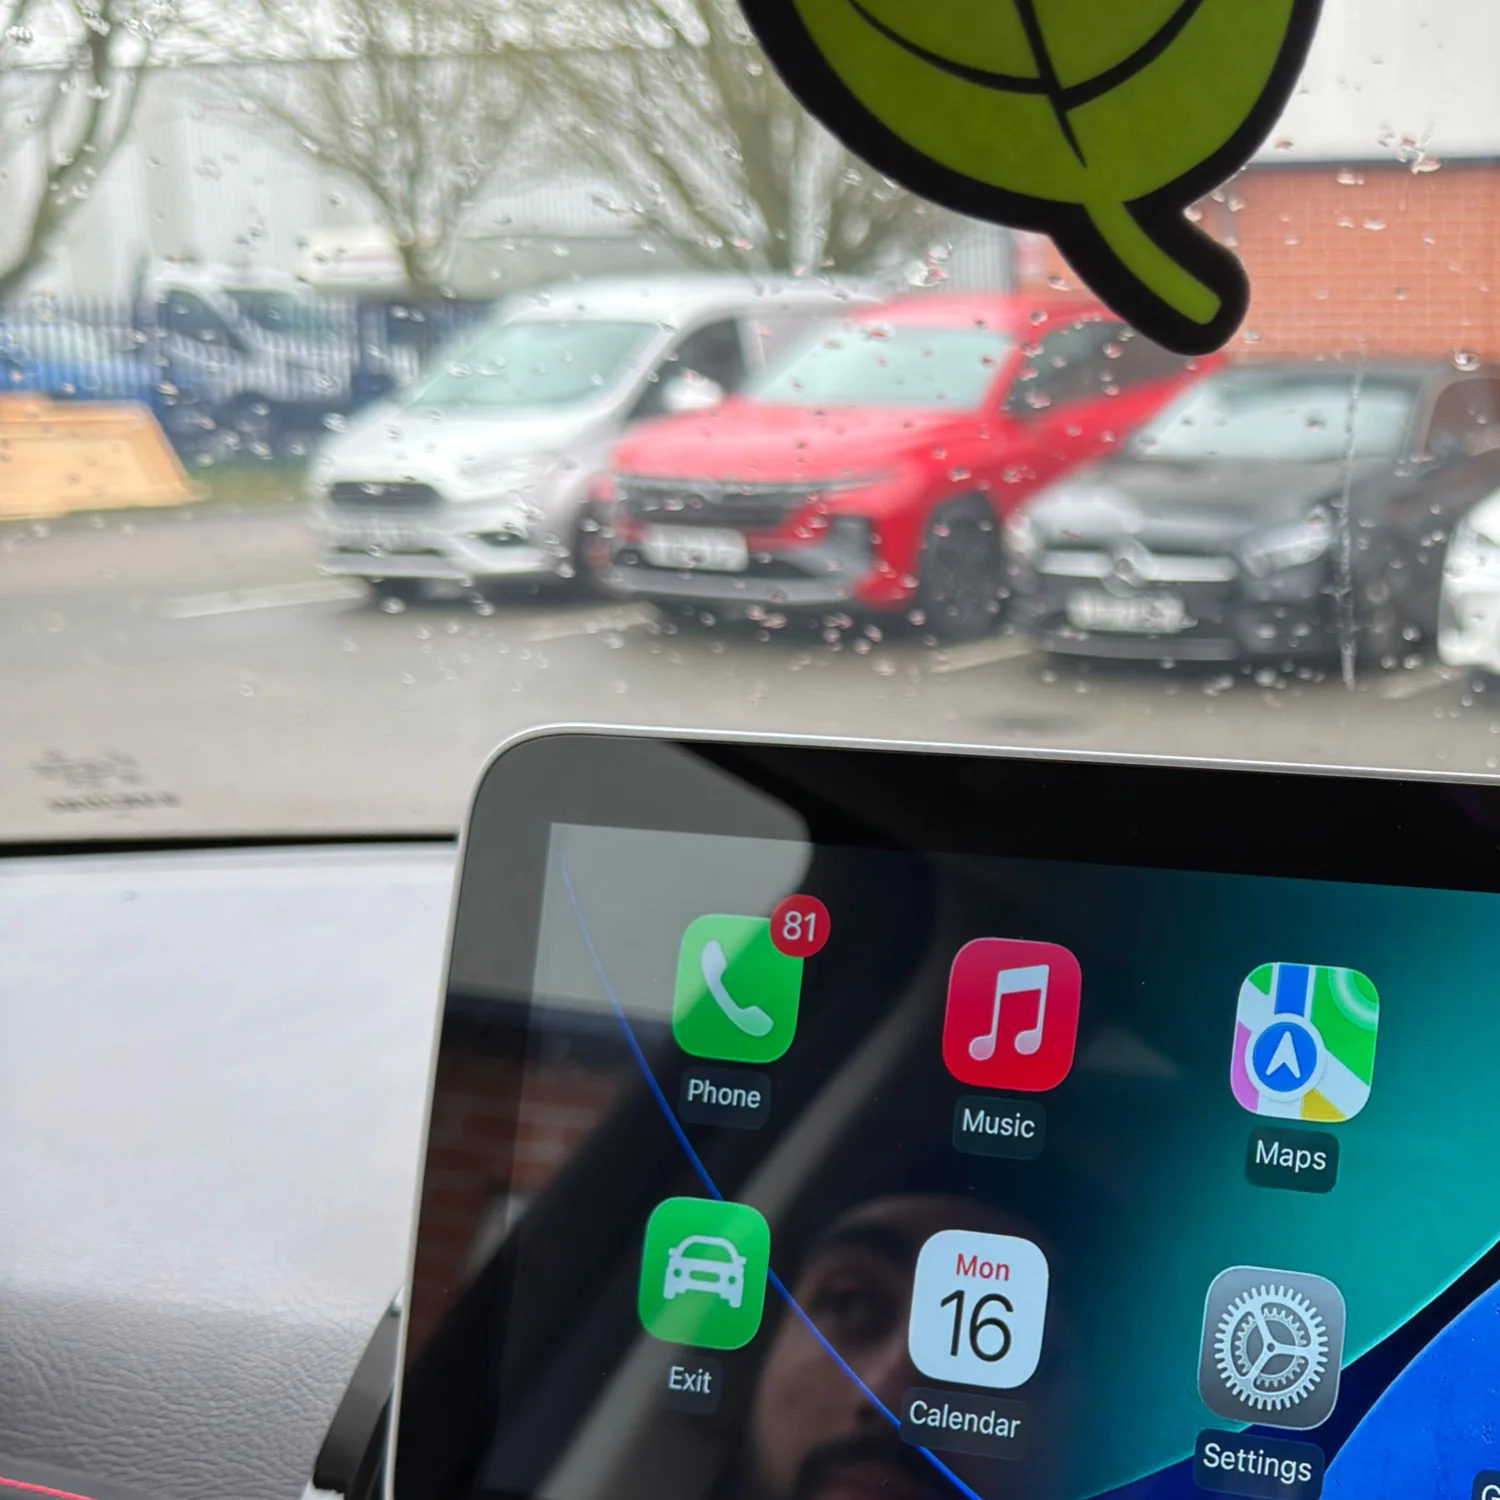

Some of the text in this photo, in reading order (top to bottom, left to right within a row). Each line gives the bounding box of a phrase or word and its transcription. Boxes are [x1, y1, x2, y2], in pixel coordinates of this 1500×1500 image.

[782, 910, 816, 943] 81
[687, 1078, 761, 1109] Phone
[961, 1108, 1036, 1139] Music
[1255, 1139, 1328, 1172] Maps
[955, 1252, 1011, 1283] Mon
[938, 1288, 1016, 1364] 16
[668, 1365, 713, 1394] Exit
[909, 1400, 1021, 1439] Calendar
[1203, 1441, 1313, 1484] Settings
